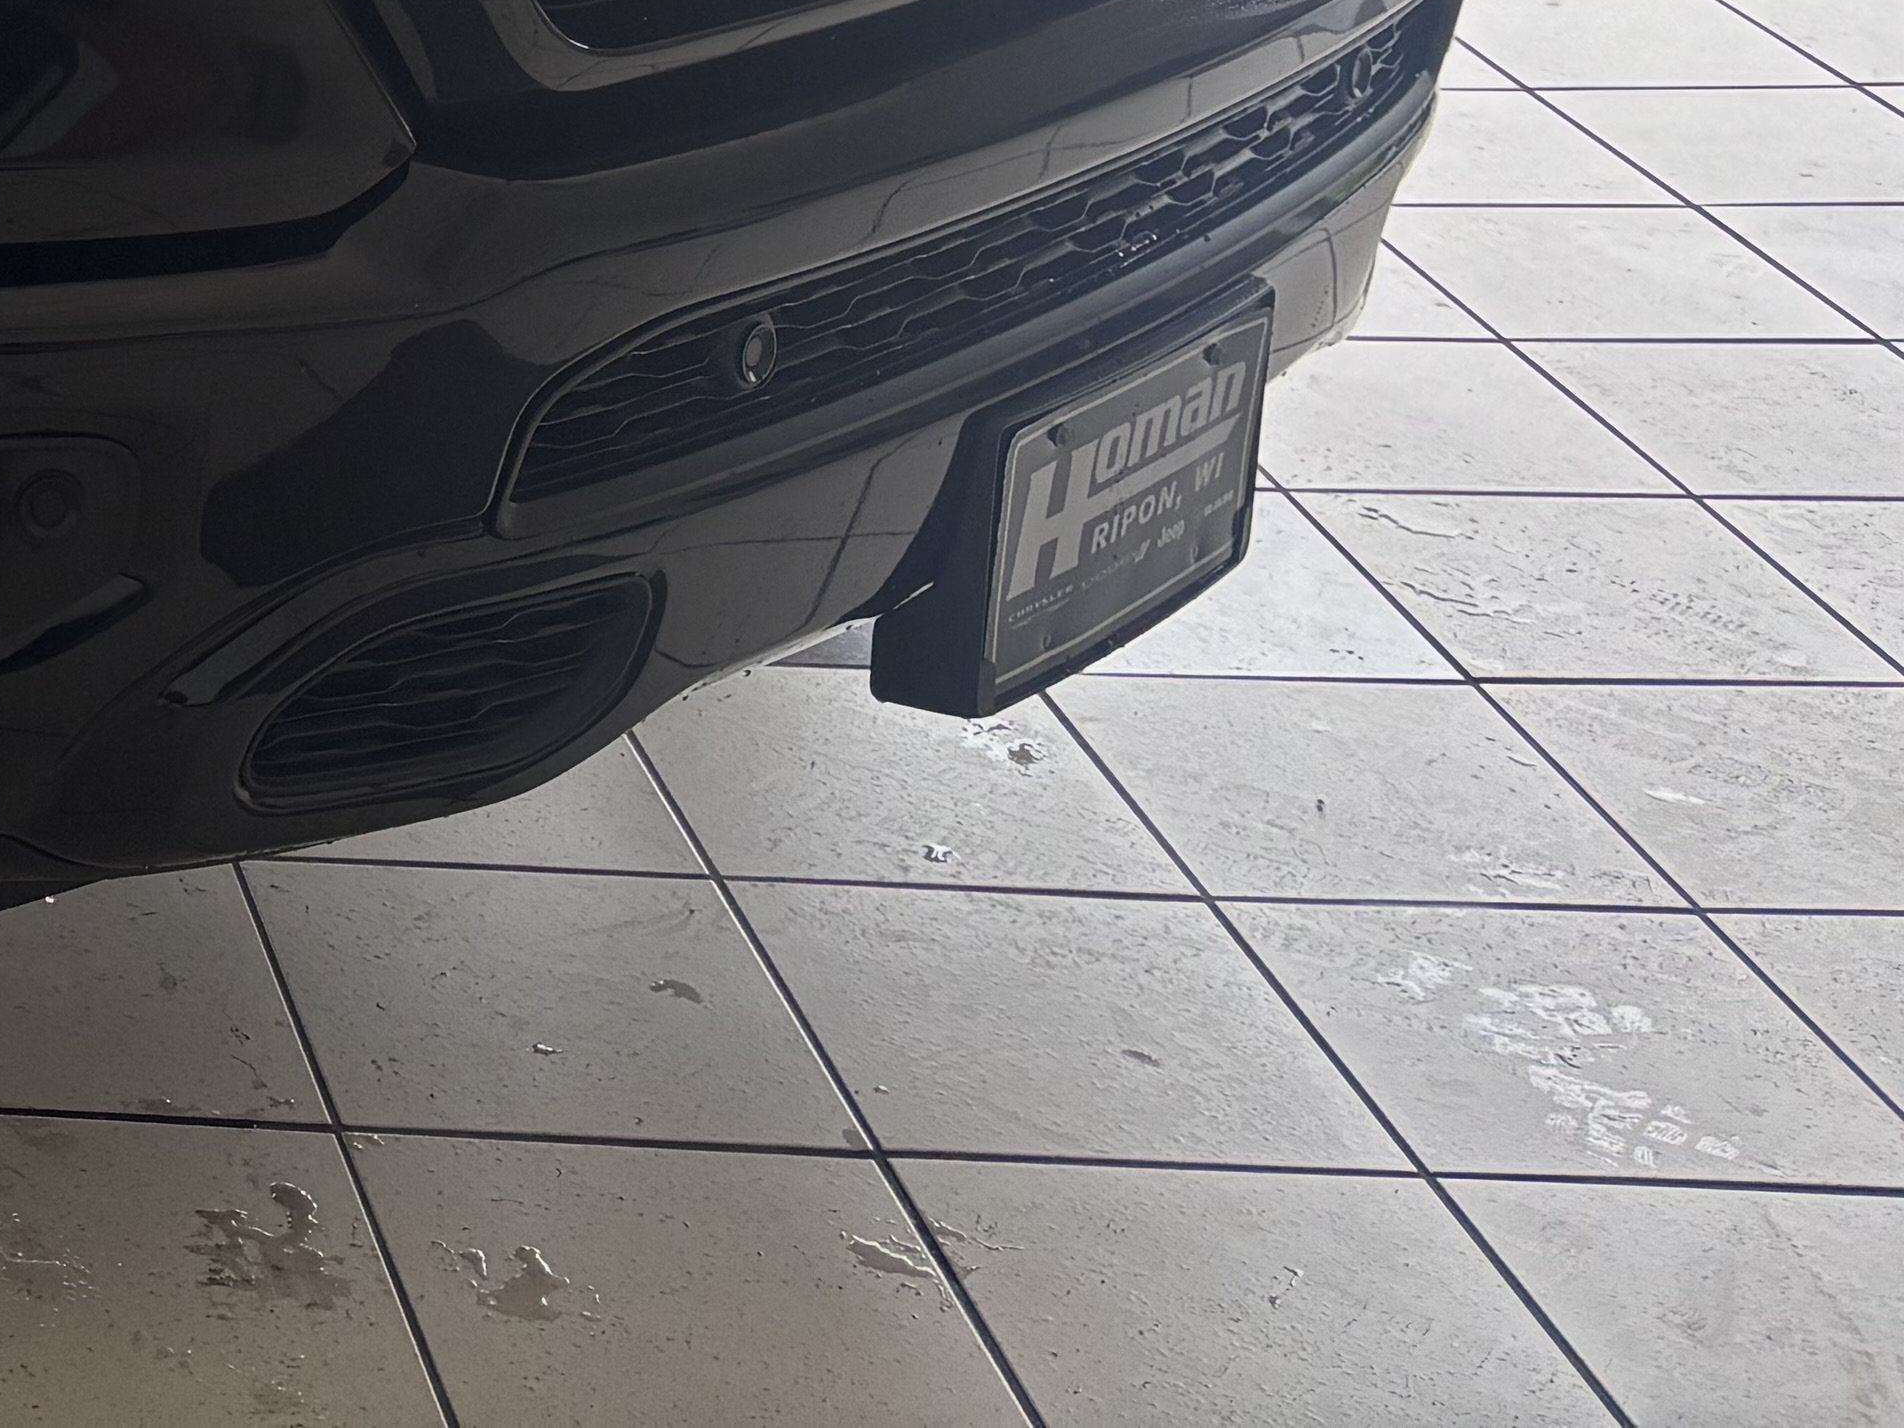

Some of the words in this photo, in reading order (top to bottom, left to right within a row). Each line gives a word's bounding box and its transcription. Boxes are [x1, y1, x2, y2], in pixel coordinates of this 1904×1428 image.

[1006, 359, 1247, 601] Homan
[1091, 481, 1182, 554] RIPON,
[1195, 452, 1224, 492] WI
[1008, 584, 1074, 622] CHRYSLER
[1157, 519, 1185, 549] Jeep
[1204, 489, 1234, 517] RAM
